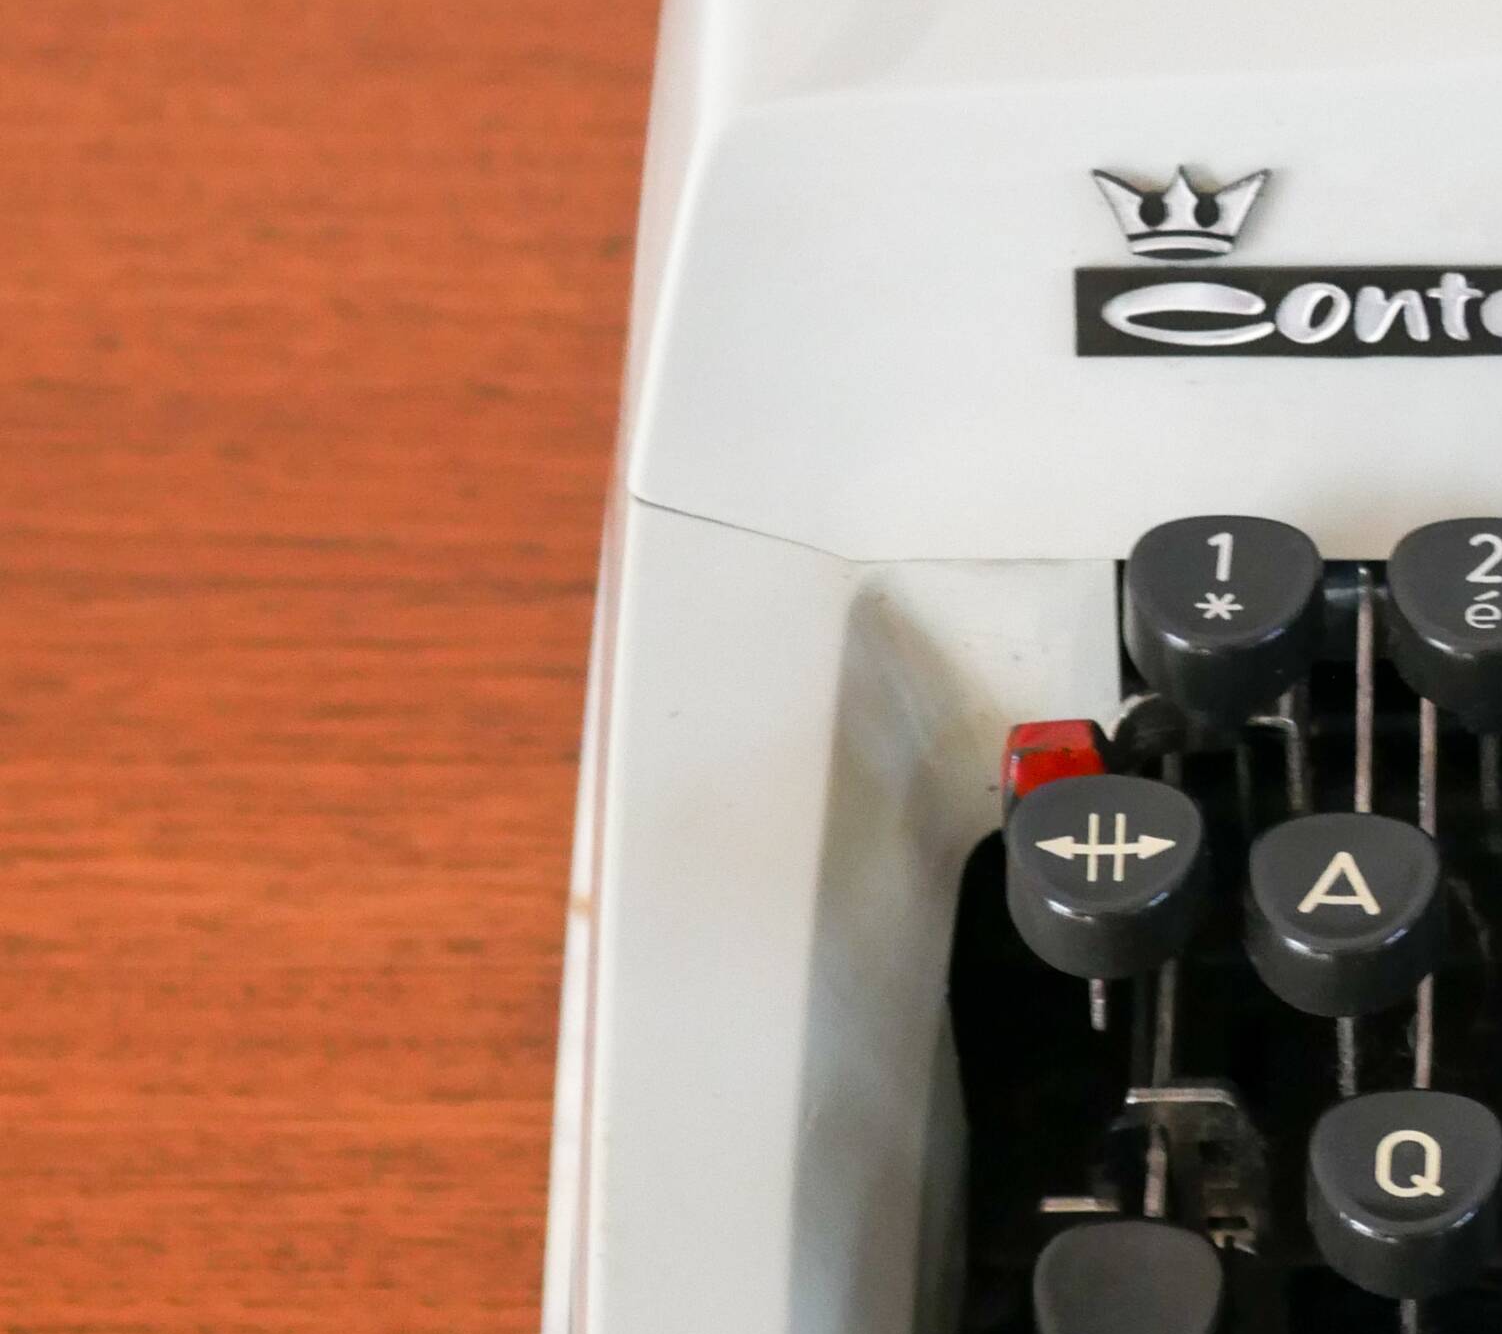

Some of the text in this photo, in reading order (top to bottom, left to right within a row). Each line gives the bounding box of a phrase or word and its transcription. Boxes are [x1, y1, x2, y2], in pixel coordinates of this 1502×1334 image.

[1208, 533, 1233, 581] 1
[1298, 852, 1380, 915] A
[1375, 1130, 1444, 1197] Q
